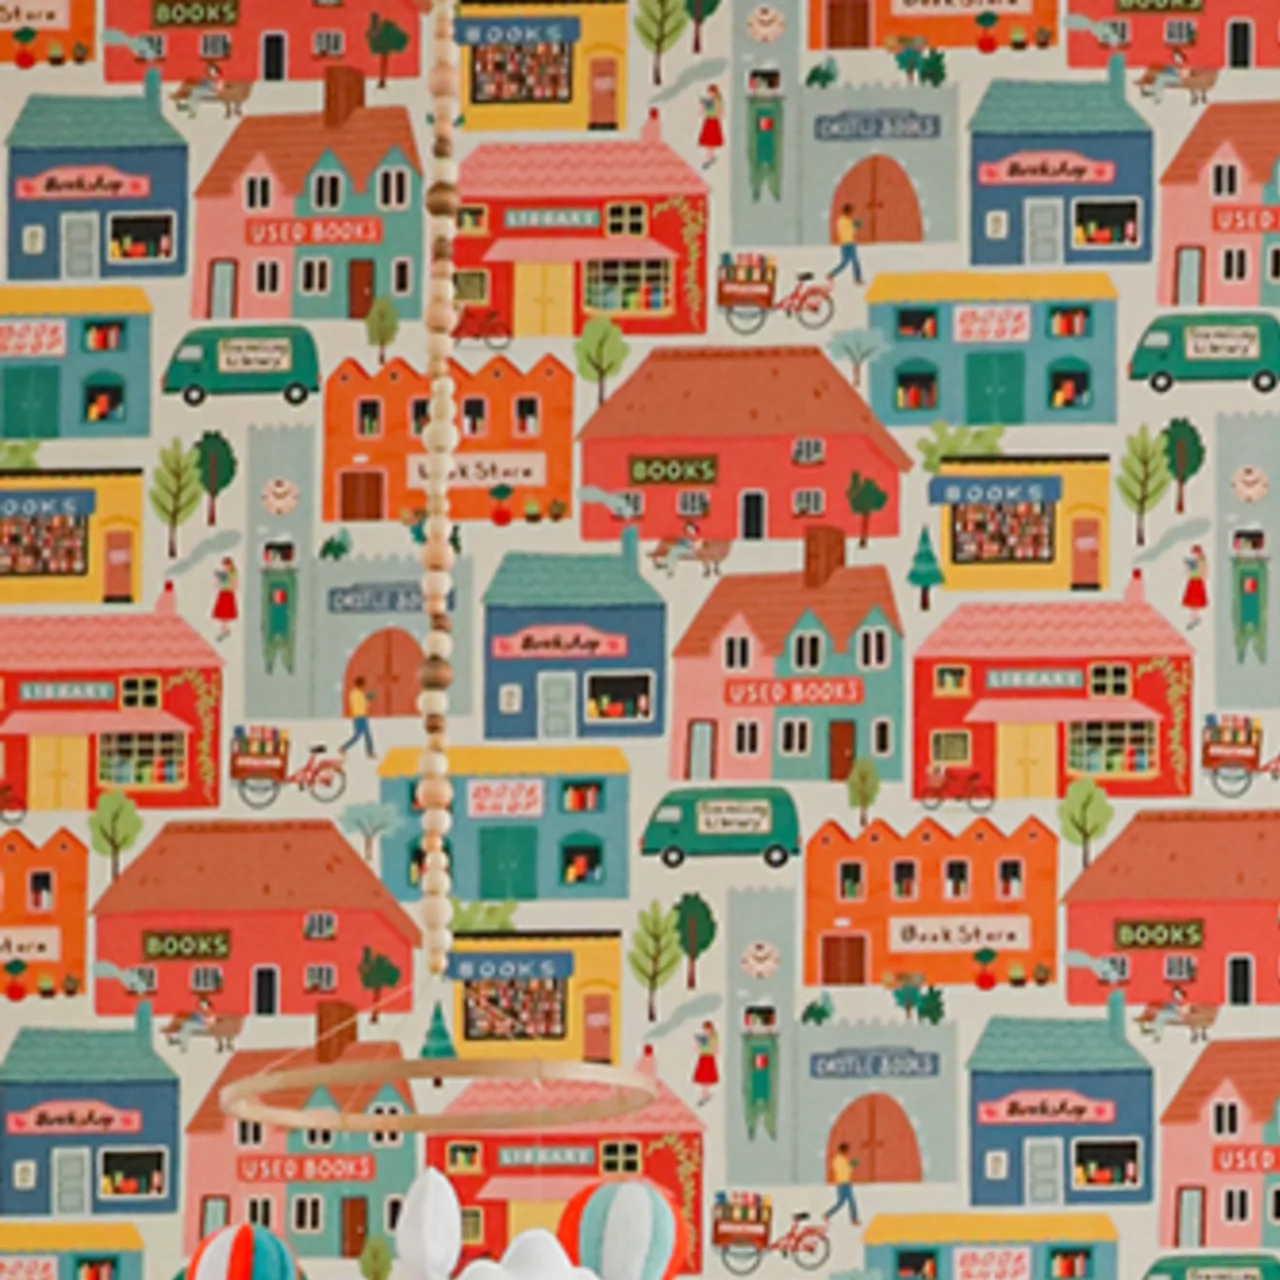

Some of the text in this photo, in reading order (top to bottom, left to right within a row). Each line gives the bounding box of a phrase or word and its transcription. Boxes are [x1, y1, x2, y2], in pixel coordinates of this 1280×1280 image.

[155, 4, 238, 22] BOOKS
[464, 26, 563, 43] BOOKS
[508, 210, 595, 226] LIBRARY
[1216, 207, 1275, 230] USED
[248, 218, 379, 242] USED BOOKS
[632, 460, 715, 478] BOOKS
[944, 485, 1043, 502] BOOKS
[991, 671, 1078, 687] LIBRARY
[23, 683, 110, 699] LIBRARY
[728, 679, 859, 703] USED BOOKS
[899, 924, 1018, 943] Book Store
[1118, 925, 1201, 943] BOOKS
[146, 935, 229, 953] BOOKS
[457, 961, 556, 978] BOOKS
[502, 1148, 589, 1164] LIBRARY
[1217, 1147, 1276, 1170] USED
[240, 1155, 371, 1179] USED BOOKS
